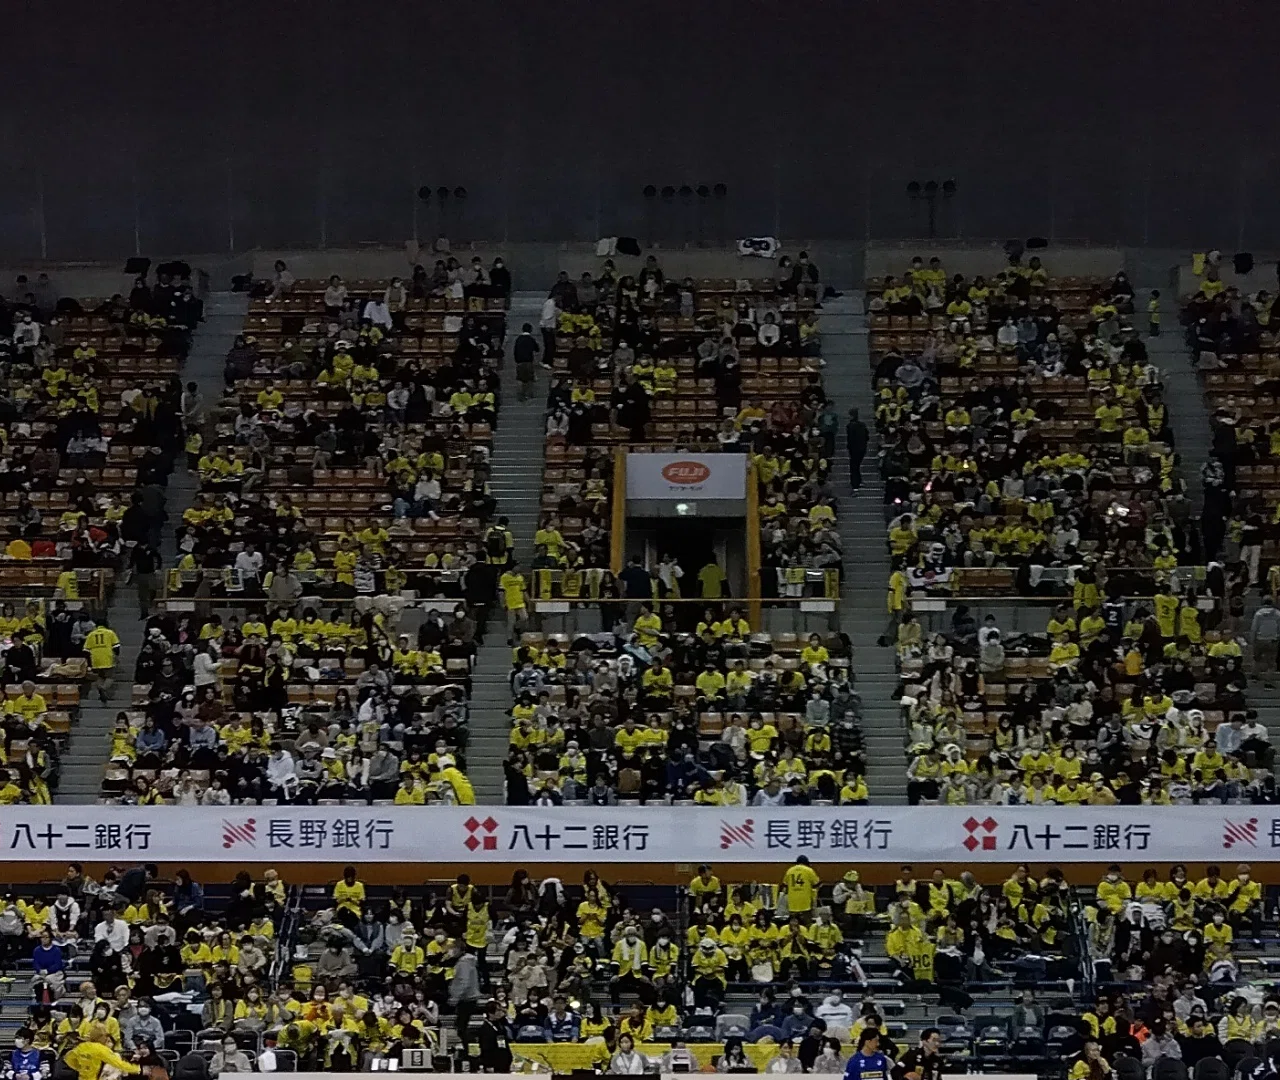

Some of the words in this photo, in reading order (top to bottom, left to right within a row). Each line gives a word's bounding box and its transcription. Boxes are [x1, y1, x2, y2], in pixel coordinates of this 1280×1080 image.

[669, 467, 705, 476] FUJI
[11, 822, 152, 850] 八十二銀行
[266, 818, 394, 849] 長野銀行
[509, 823, 649, 851] 八十二銀行
[764, 818, 893, 849] 長野銀行
[1007, 823, 1151, 851] 八十二銀行
